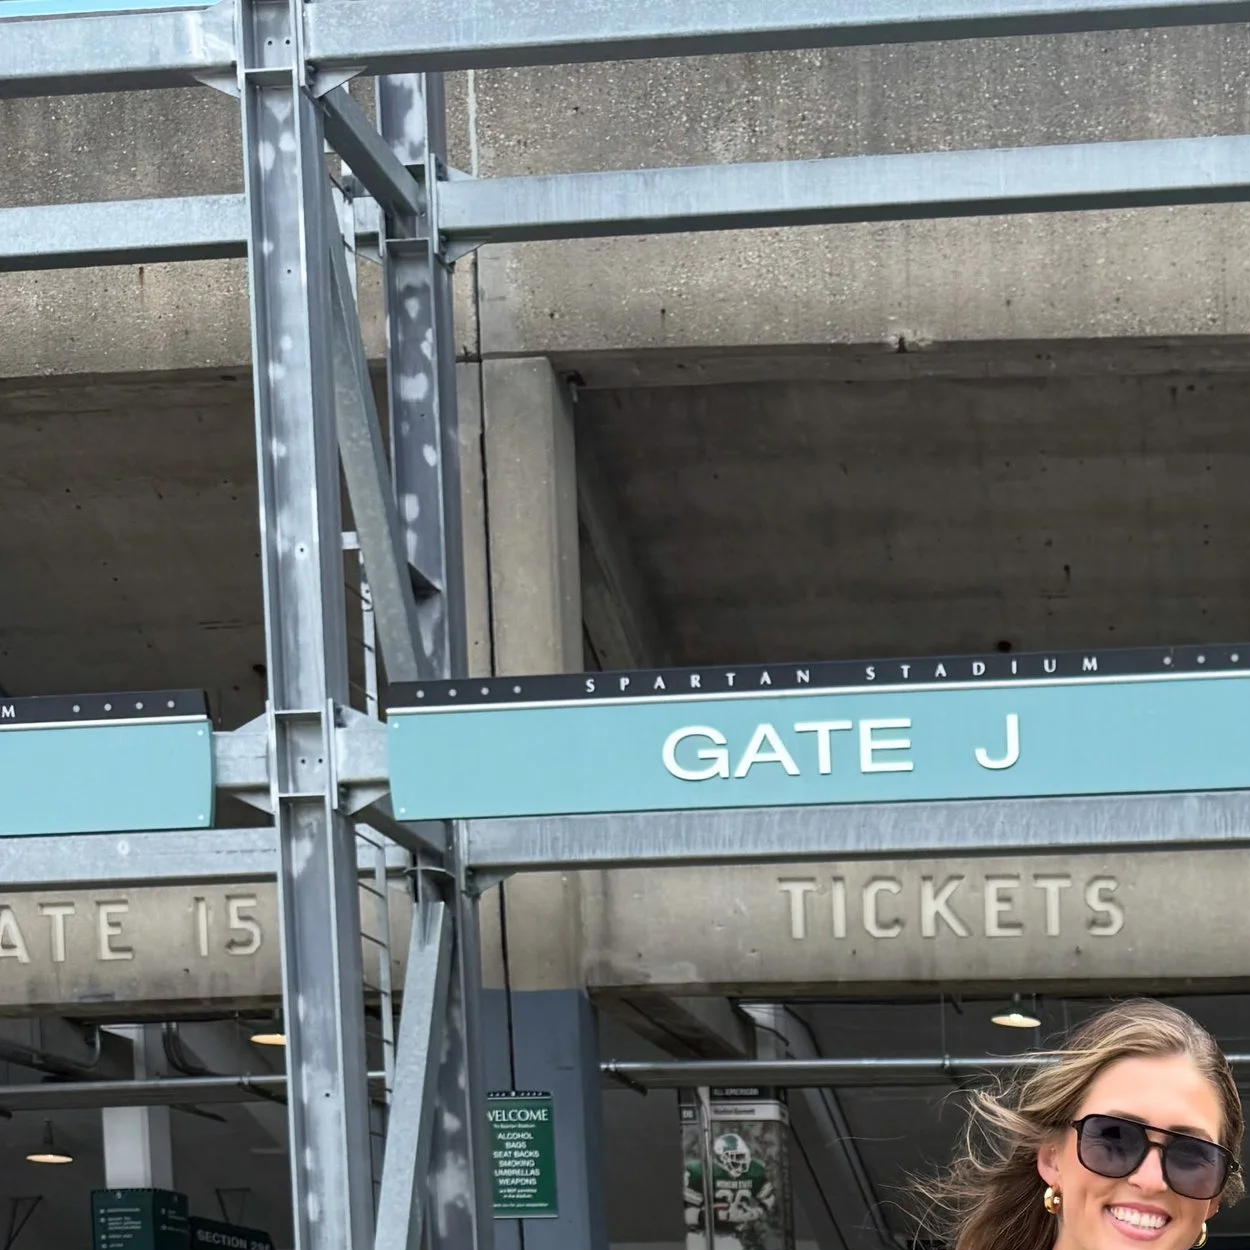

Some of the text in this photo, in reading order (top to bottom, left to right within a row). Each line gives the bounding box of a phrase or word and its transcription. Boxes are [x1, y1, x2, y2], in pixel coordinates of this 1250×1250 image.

[586, 657, 1099, 693] SPARTAN STADIUM
[662, 713, 1021, 782] GATE J
[777, 874, 1125, 940] TICKETS
[0, 893, 262, 964] ATE 15
[497, 1132, 534, 1140] ALCOHOL
[505, 1141, 527, 1149] BAGS
[493, 1150, 540, 1159] SEAT BACKS
[499, 1159, 536, 1168] SMOKING
[494, 1168, 541, 1177] UMBRELLAS
[499, 1177, 537, 1186] WEAPONS
[196, 1228, 248, 1250] SECTION
